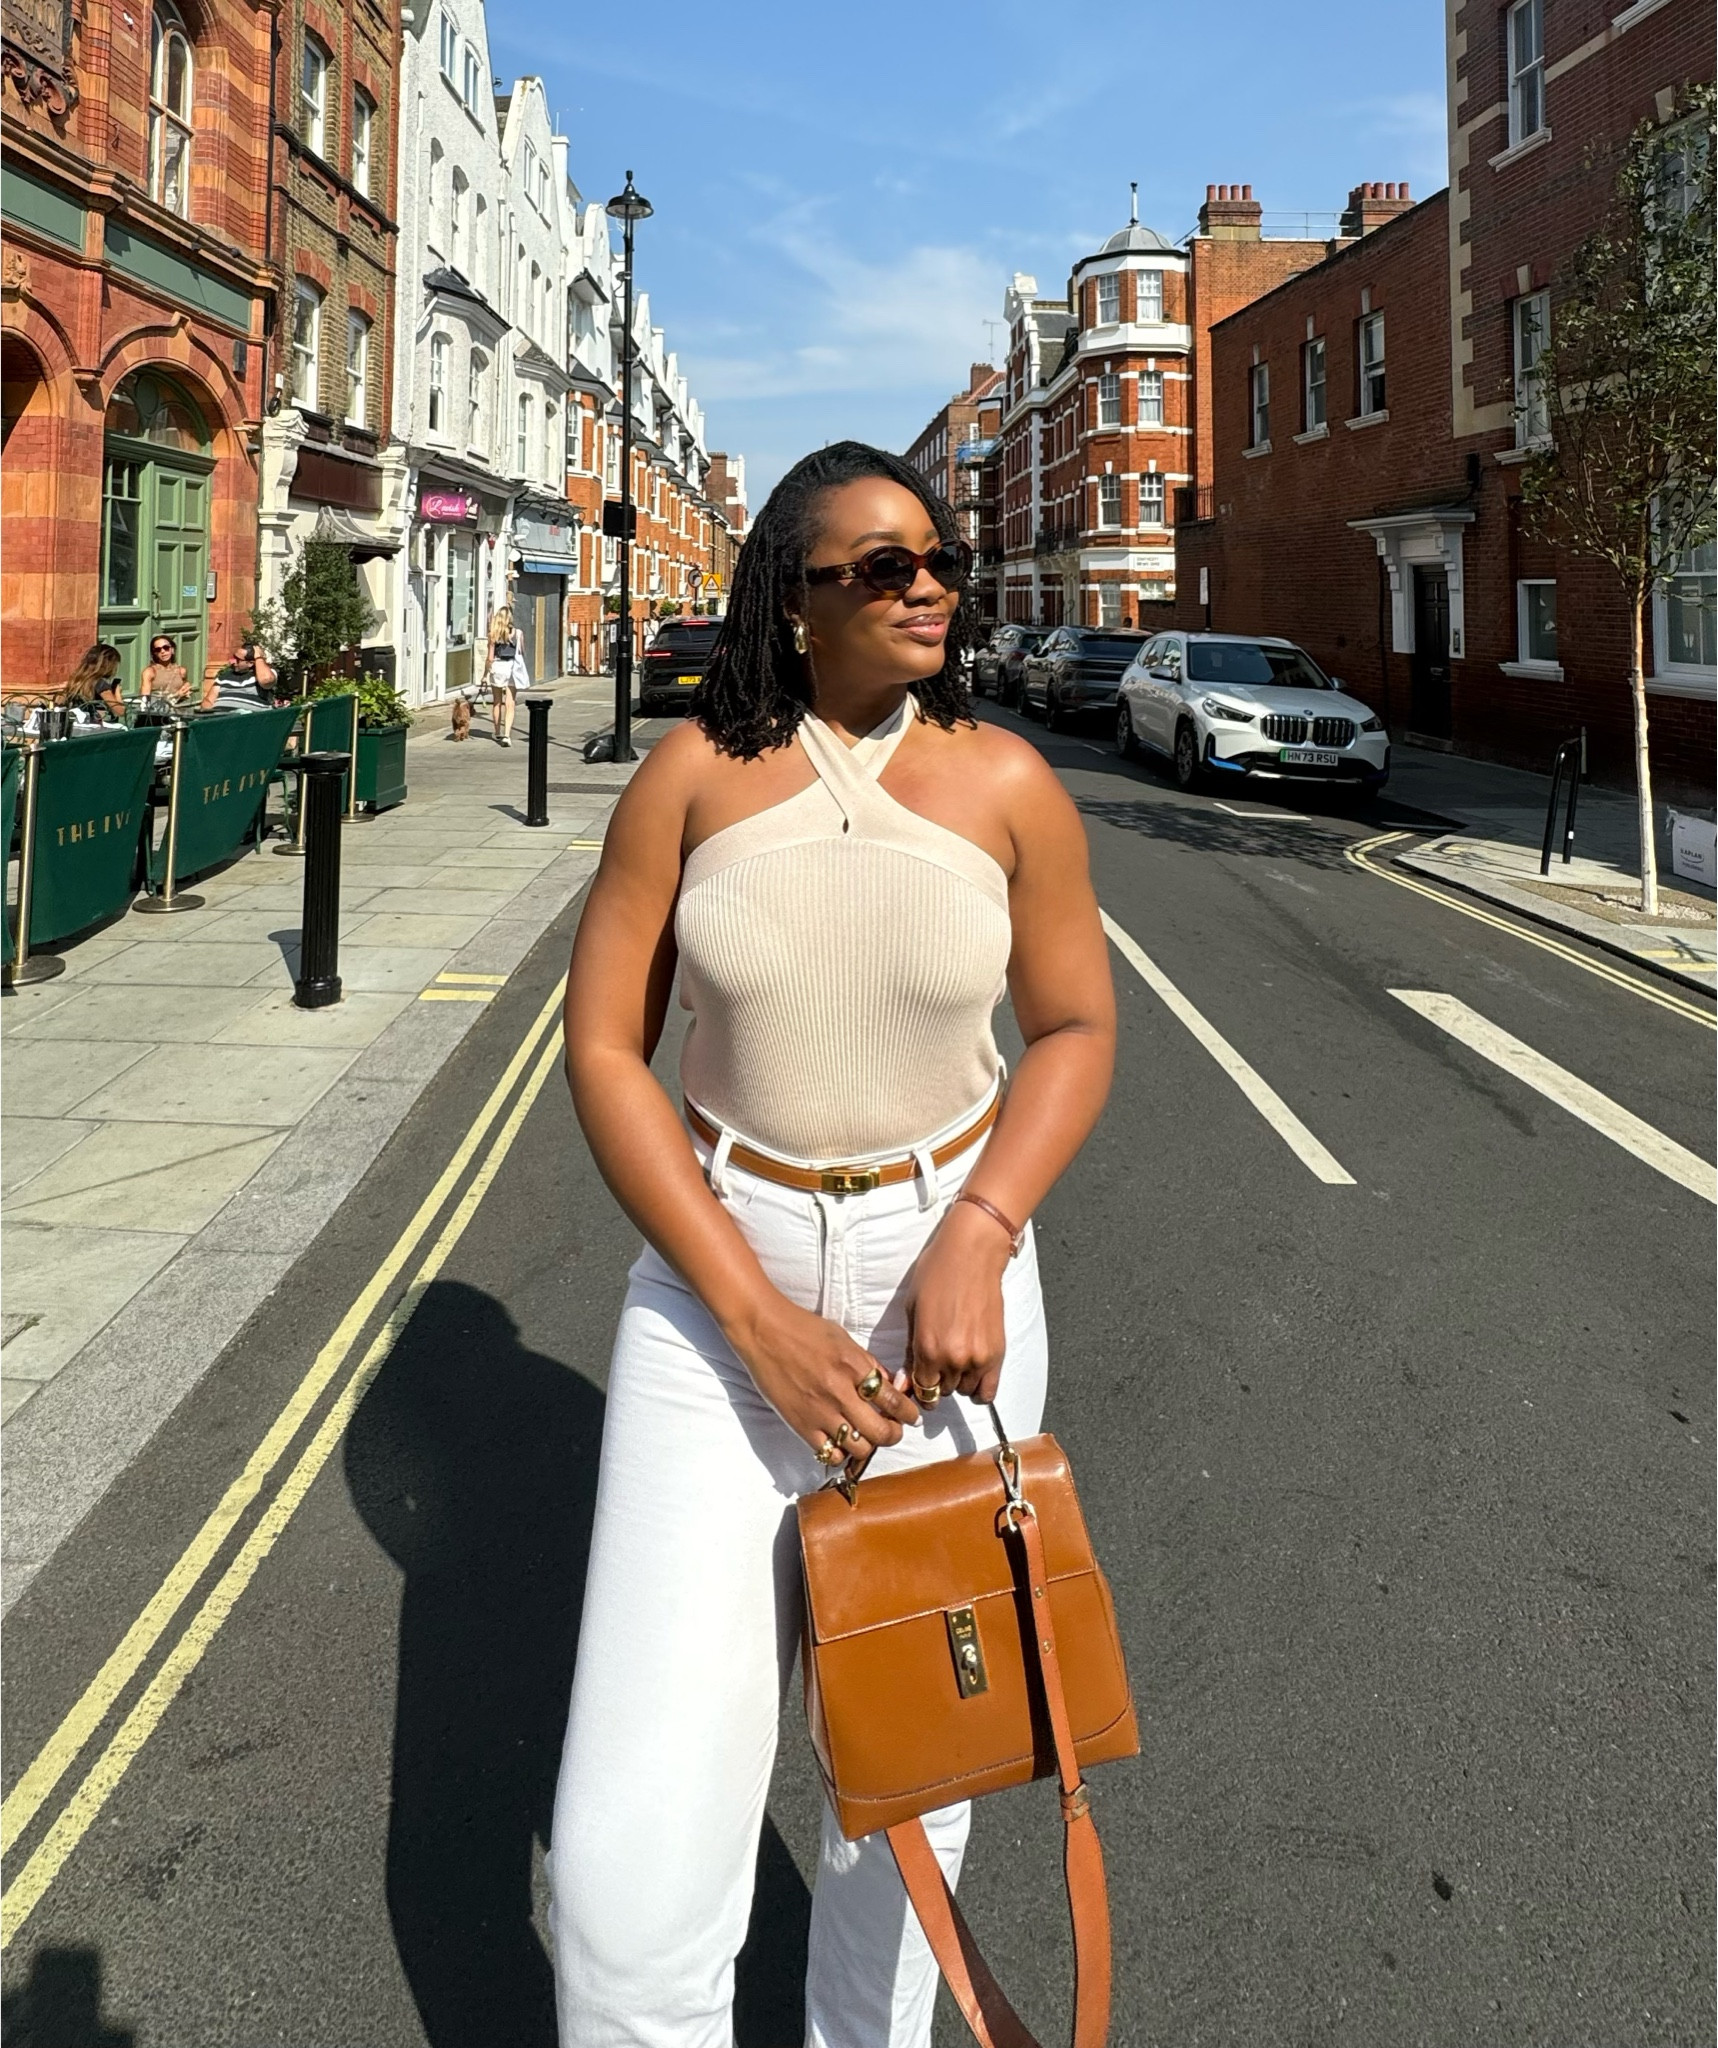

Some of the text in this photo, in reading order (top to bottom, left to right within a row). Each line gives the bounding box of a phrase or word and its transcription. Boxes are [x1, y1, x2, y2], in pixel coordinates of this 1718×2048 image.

[1287, 751, 1337, 764] HN73 RSU
[202, 769, 269, 804] THE IVY
[56, 820, 95, 847] THE
